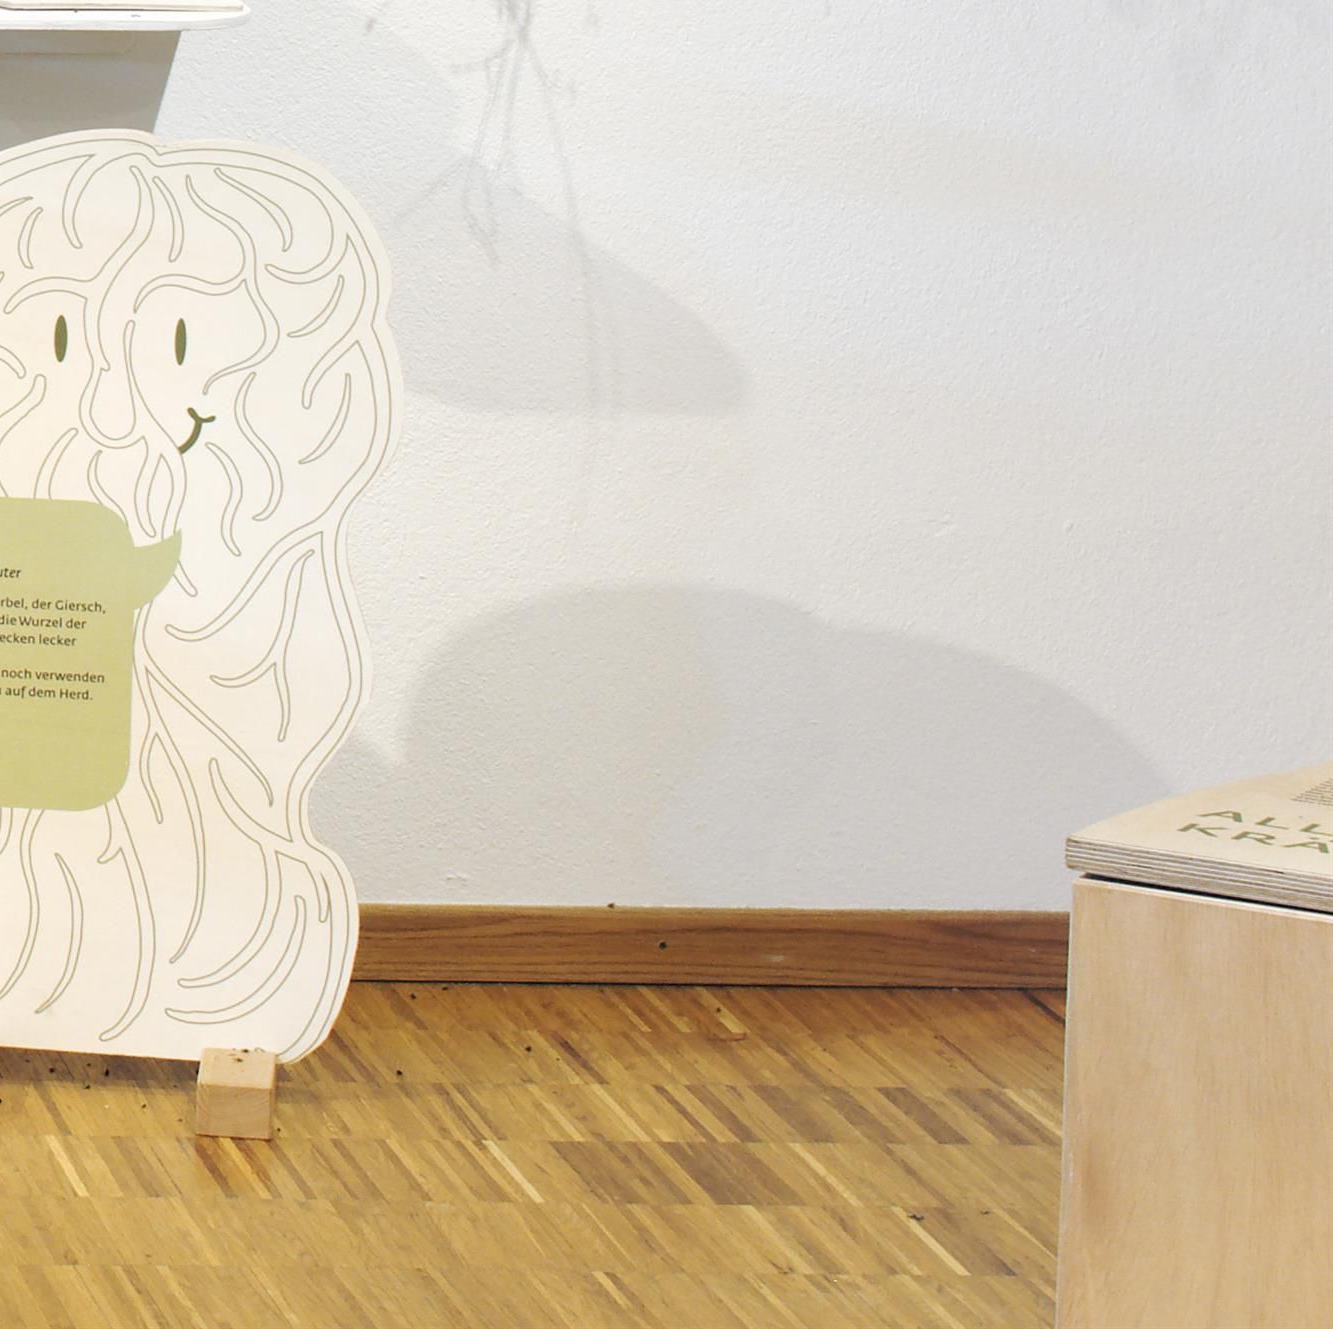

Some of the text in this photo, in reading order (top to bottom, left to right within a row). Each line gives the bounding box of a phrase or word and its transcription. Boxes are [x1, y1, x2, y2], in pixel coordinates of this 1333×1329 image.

[31, 598, 52, 609] der
[54, 599, 106, 614] Giersch,
[18, 615, 62, 628] Wurzel
[65, 617, 87, 629] der
[38, 633, 77, 646] lecker
[1, 668, 32, 679] noch
[35, 671, 104, 683] verwenden
[4, 685, 25, 699] auf
[27, 686, 56, 698] dem
[59, 688, 92, 700] Herd.
